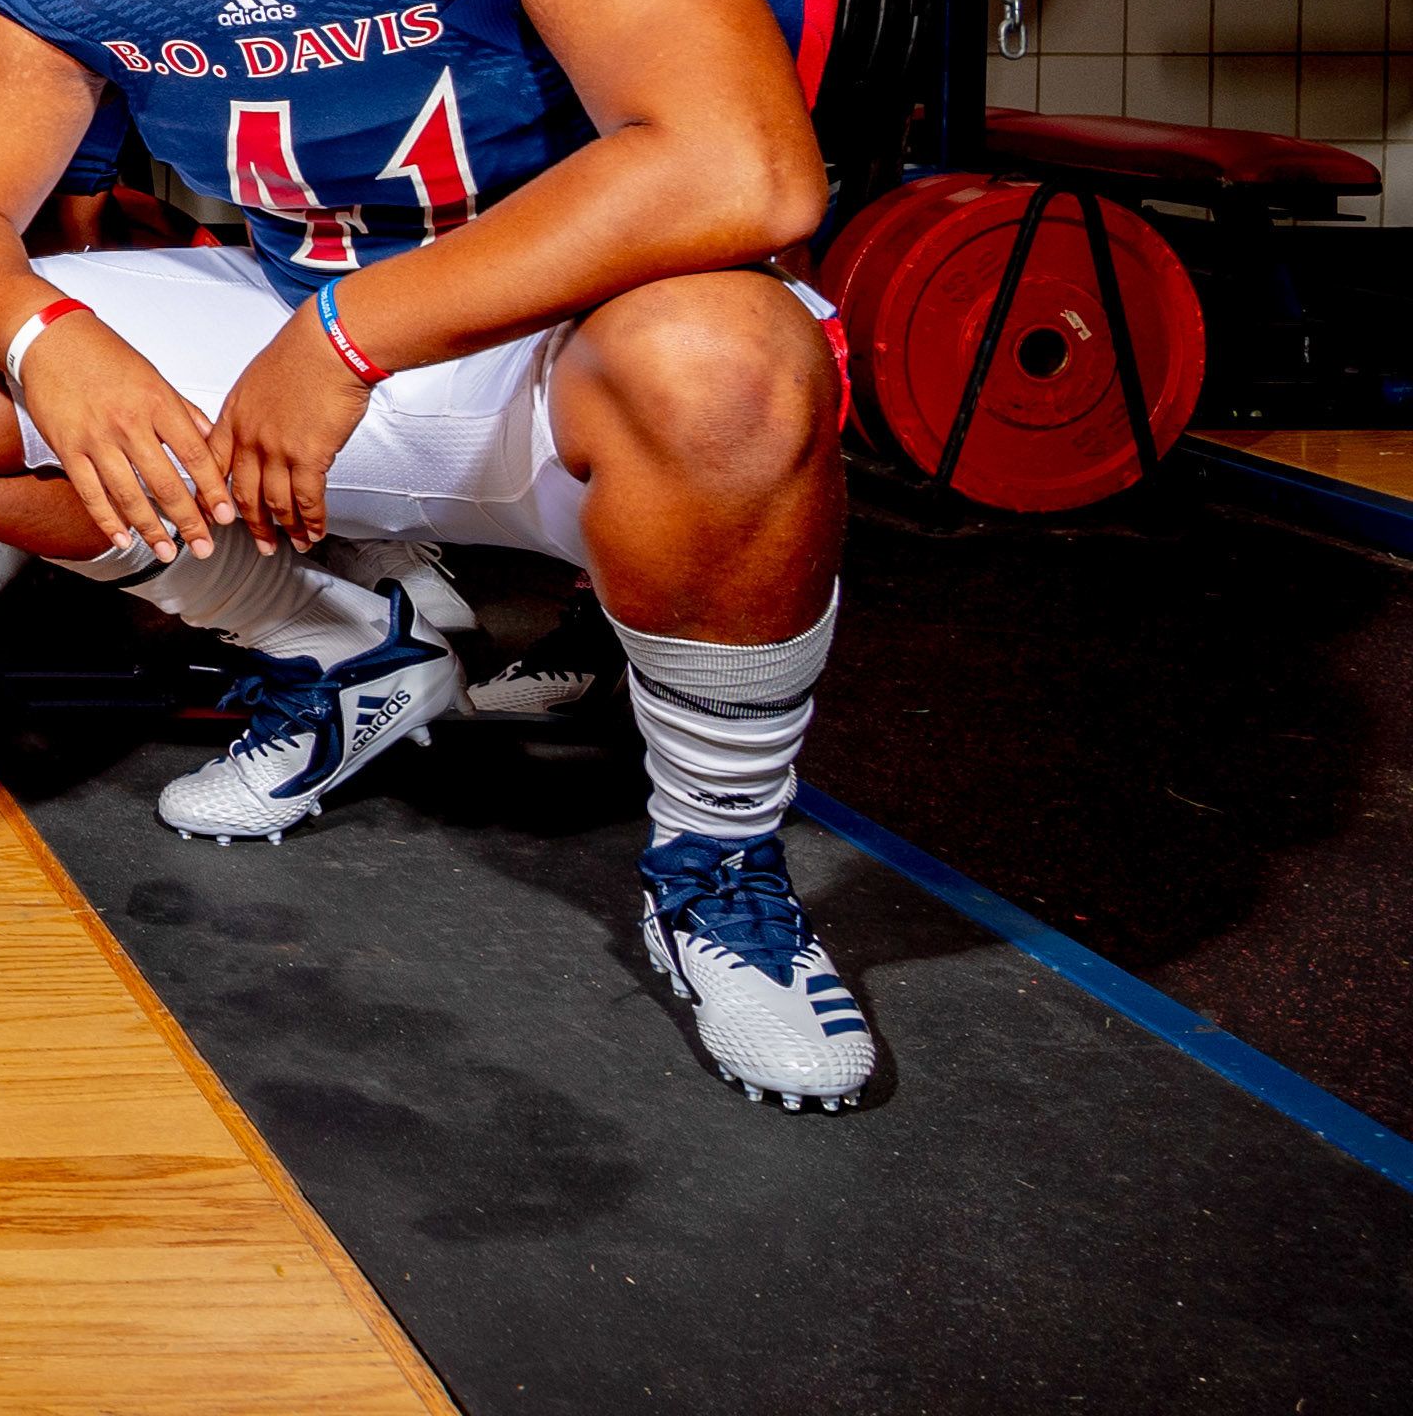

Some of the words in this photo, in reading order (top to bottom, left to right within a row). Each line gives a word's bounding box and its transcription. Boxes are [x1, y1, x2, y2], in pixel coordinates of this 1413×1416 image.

[101, 39, 227, 79] B.O.
[235, 2, 444, 79] DAVIS
[217, 3, 297, 27] adidas
[351, 689, 412, 753] adidas
